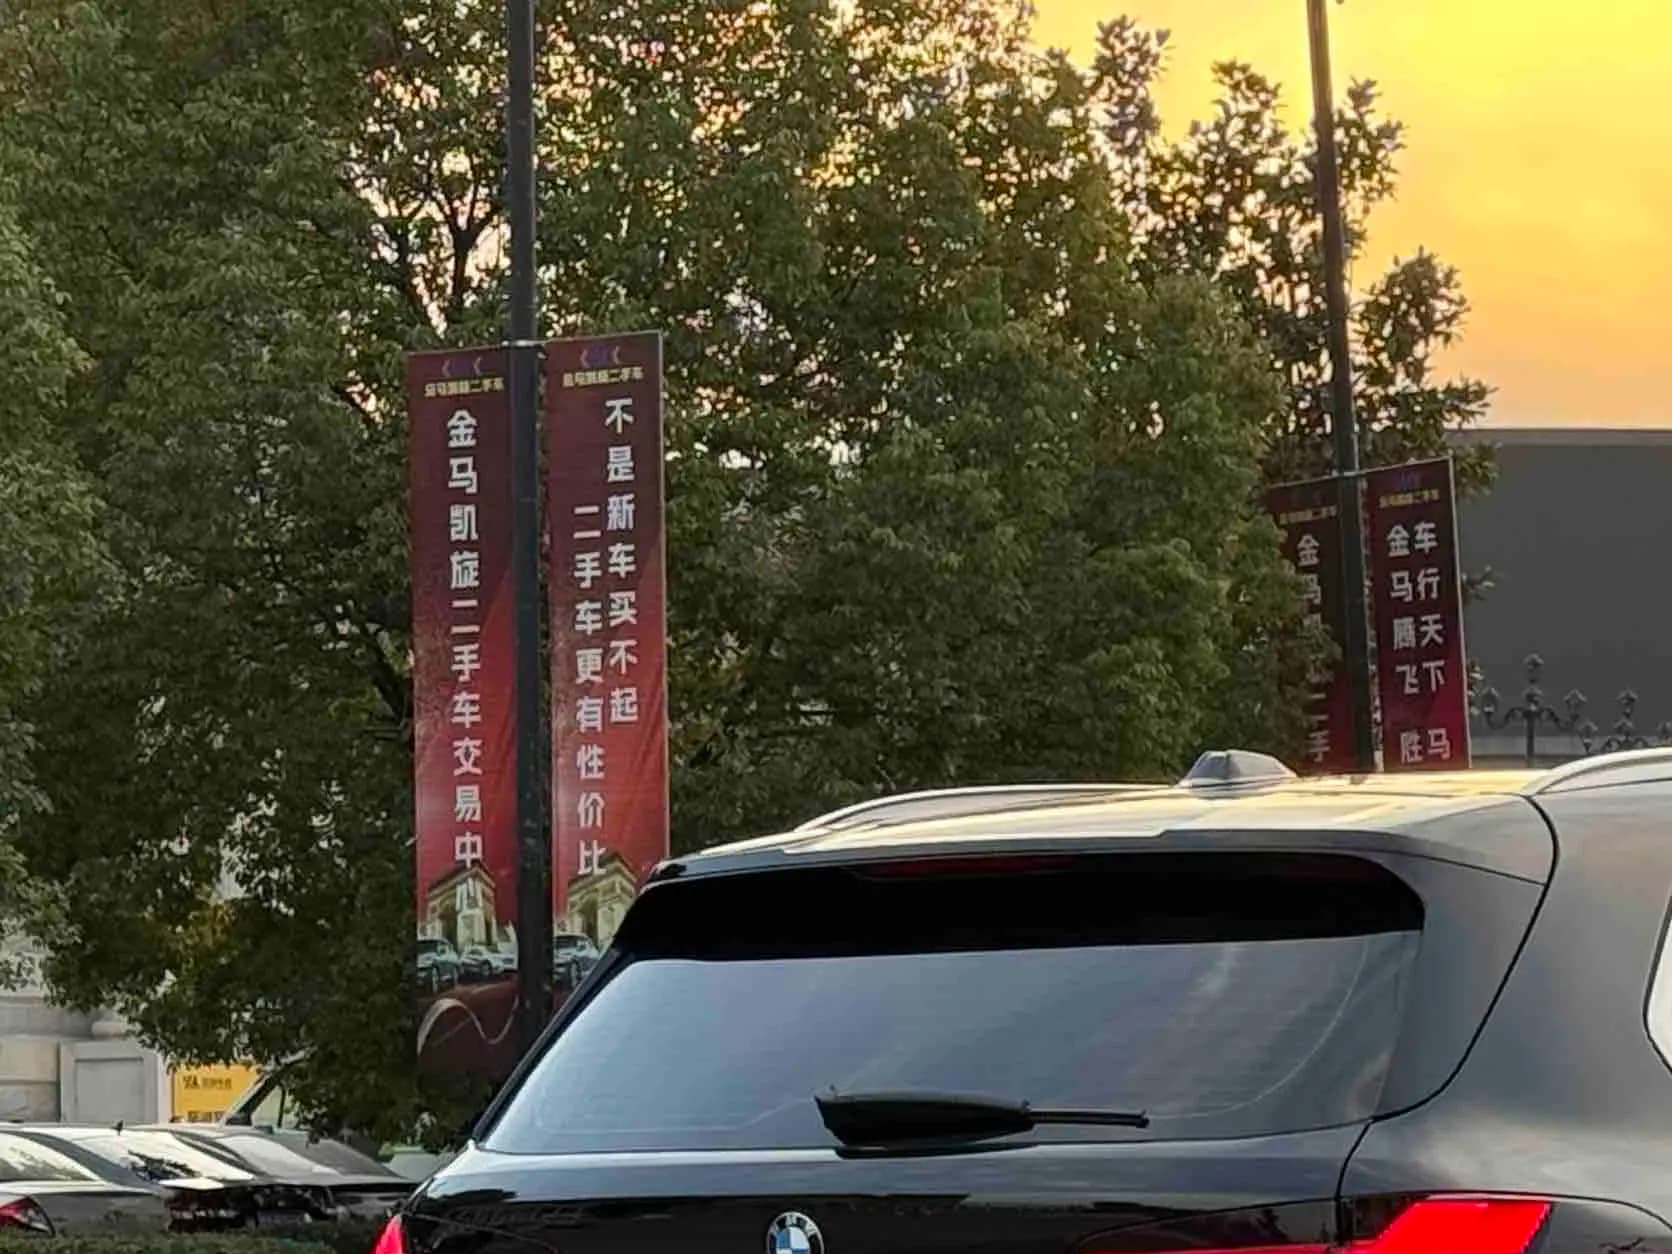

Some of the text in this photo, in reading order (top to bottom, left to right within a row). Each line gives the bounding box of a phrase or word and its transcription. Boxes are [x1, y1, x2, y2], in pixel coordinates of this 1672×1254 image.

[447, 408, 484, 911] 金马凯旋二手车交易中心
[573, 504, 607, 876] 二手车更有性价比
[604, 397, 640, 723] 不是新车买不起
[1296, 534, 1330, 763] 金马二手
[1414, 521, 1446, 692] 车行天下
